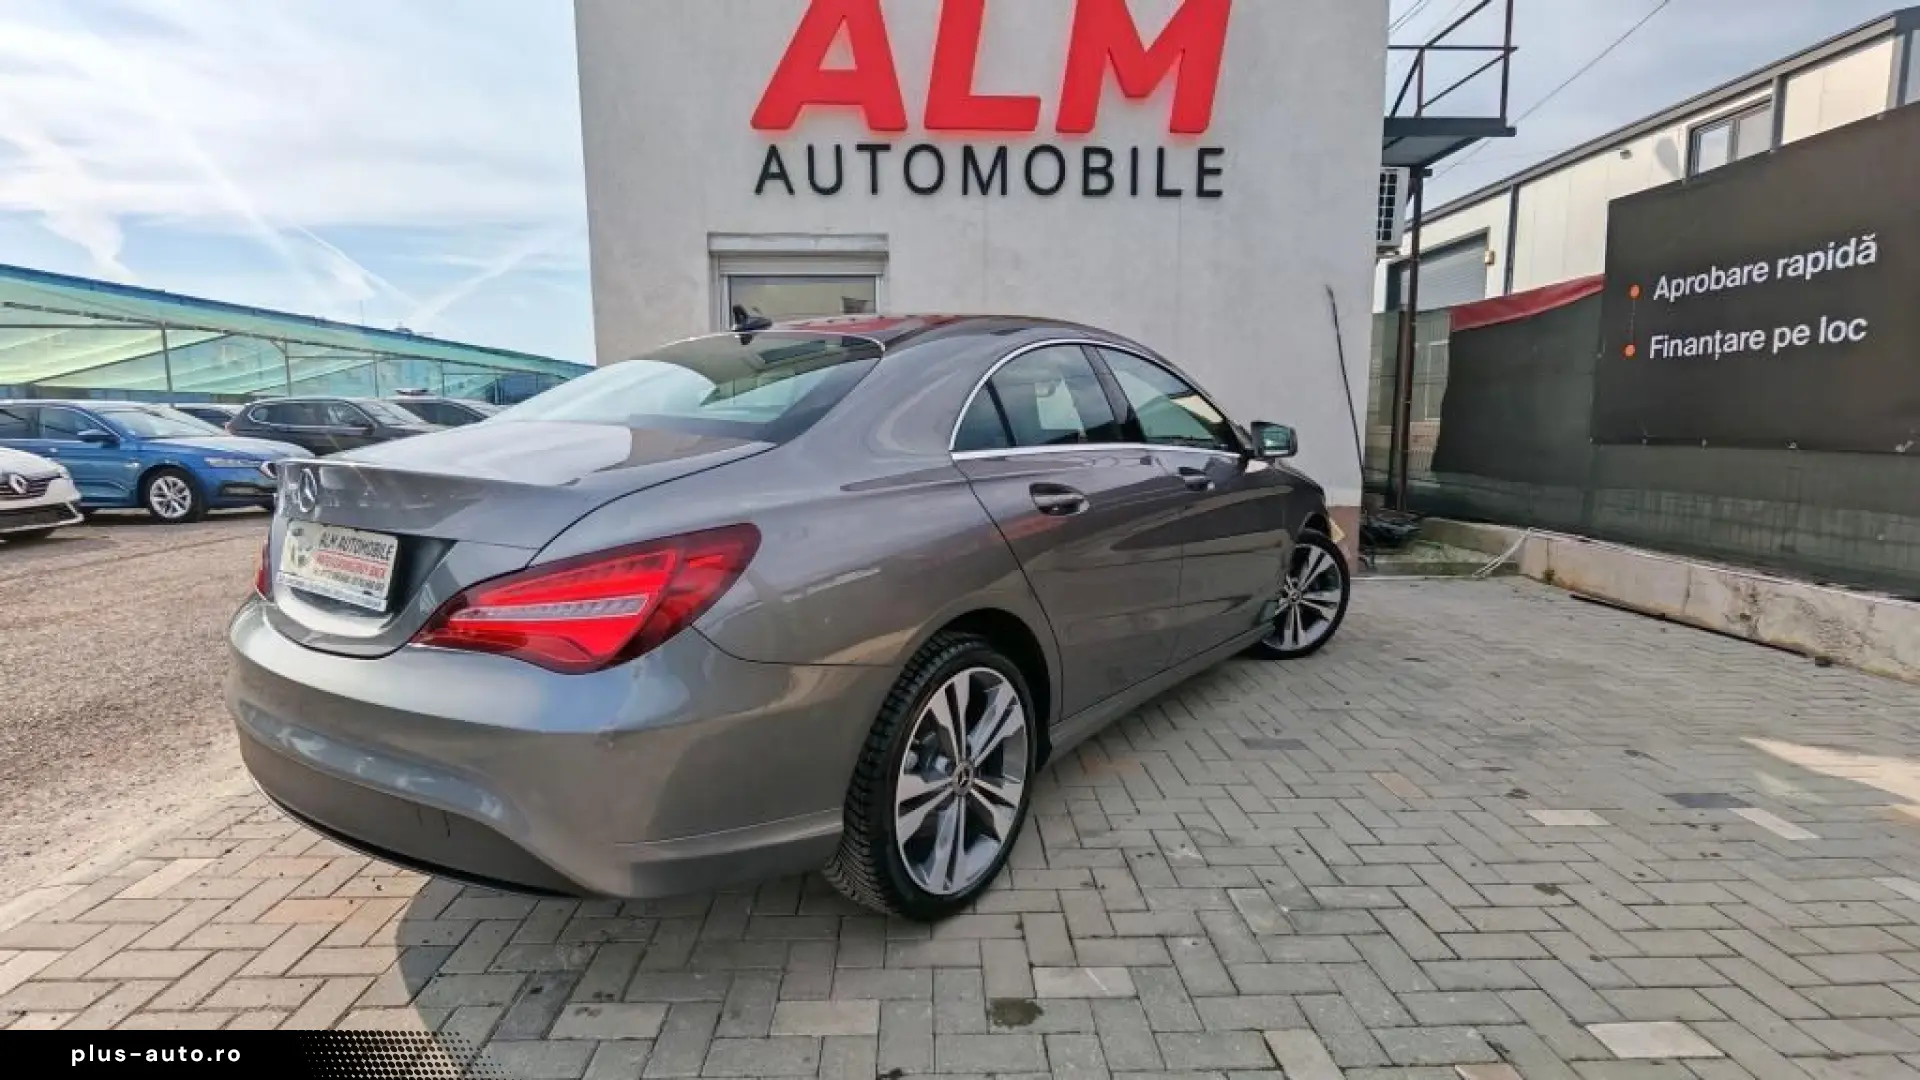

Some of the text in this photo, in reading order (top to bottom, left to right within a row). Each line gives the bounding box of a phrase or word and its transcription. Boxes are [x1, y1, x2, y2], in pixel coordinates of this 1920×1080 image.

[750, 0, 1231, 133] ALM
[754, 143, 1225, 198] AUTOMOBILE
[1653, 233, 1878, 303] Aprobare rapidă
[1773, 324, 1811, 354] pe
[1818, 315, 1868, 344] loc
